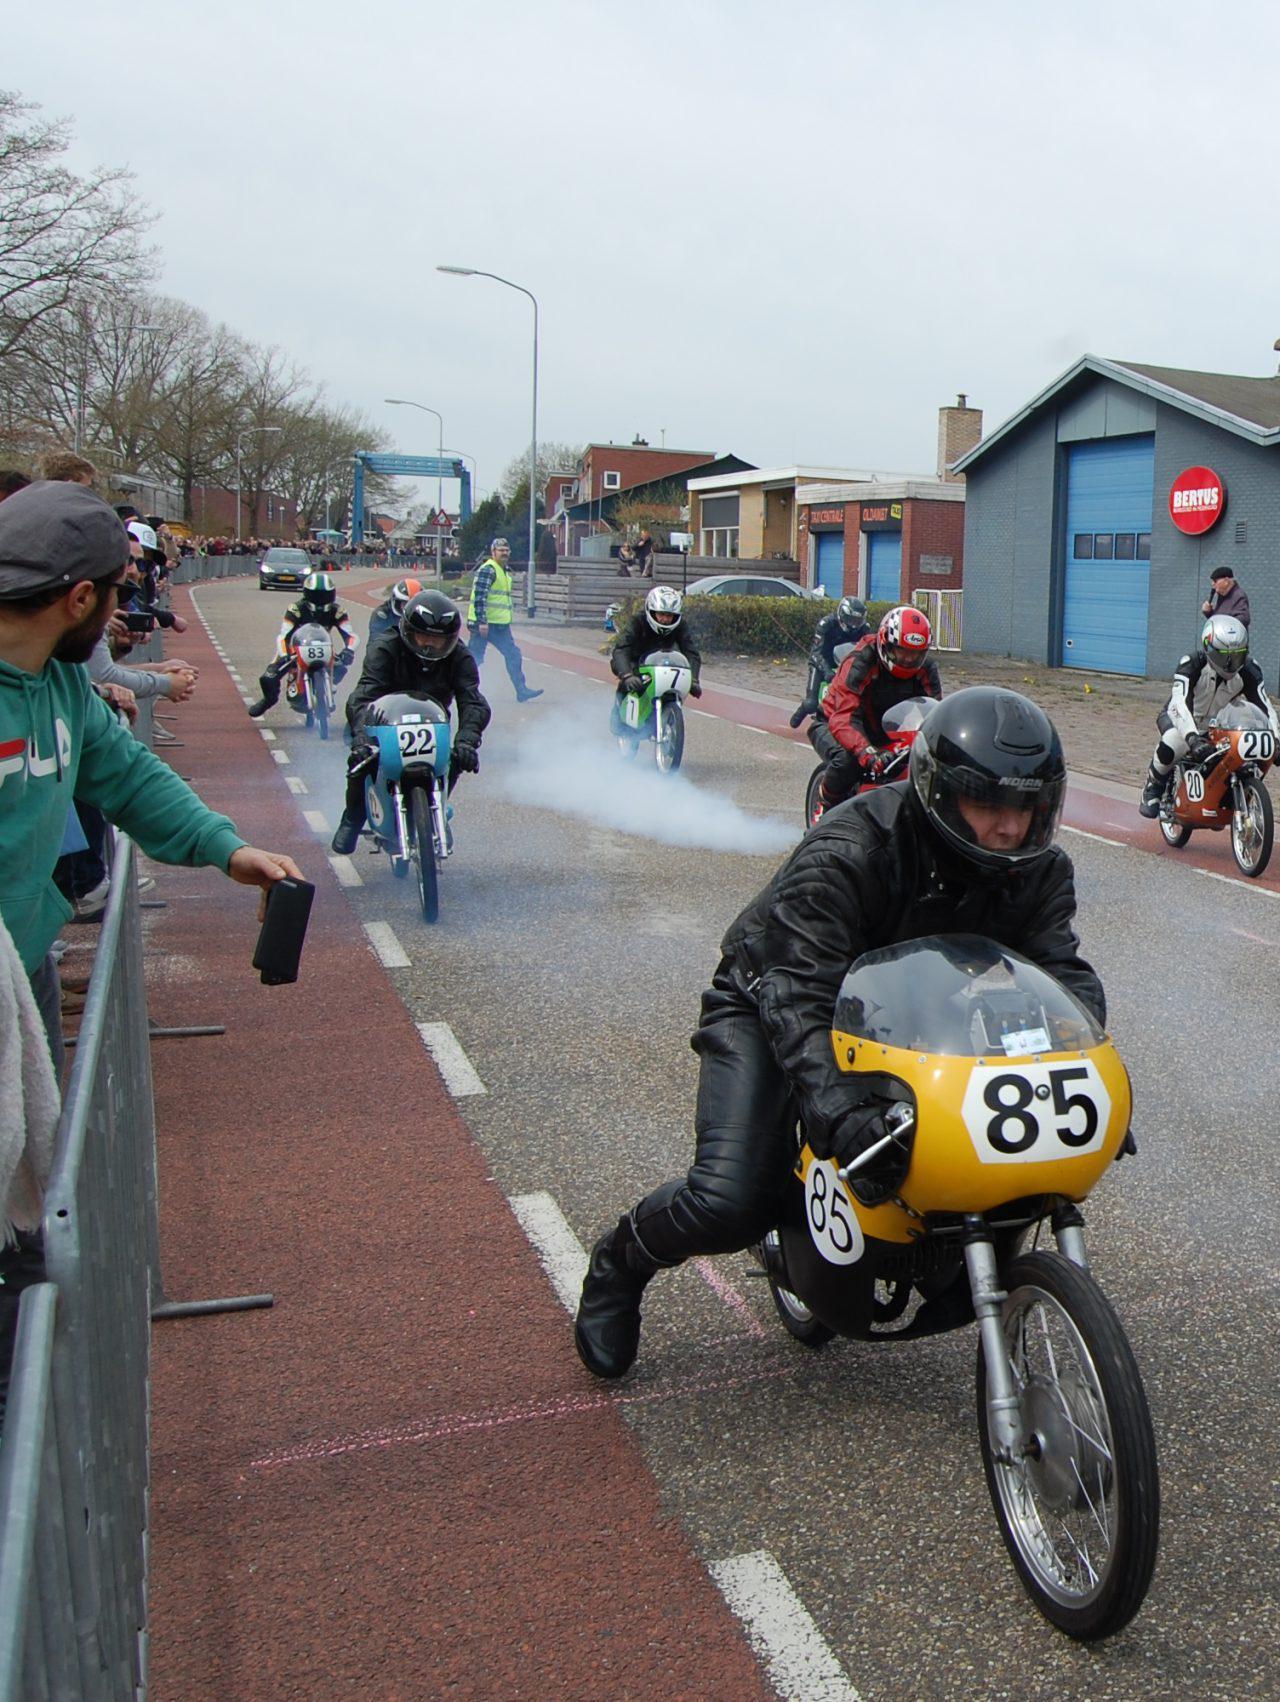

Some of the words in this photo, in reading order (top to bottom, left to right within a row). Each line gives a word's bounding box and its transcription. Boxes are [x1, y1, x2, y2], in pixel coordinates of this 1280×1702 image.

[1173, 487, 1218, 508] BERTUS
[307, 647, 325, 659] 83
[670, 668, 681, 689] 7
[399, 728, 436, 758] 22
[1243, 732, 1273, 759] 20
[998, 776, 1044, 792] NOLAN
[1187, 771, 1202, 799] 20
[983, 1067, 1099, 1154] 85
[810, 1167, 853, 1254] 85
